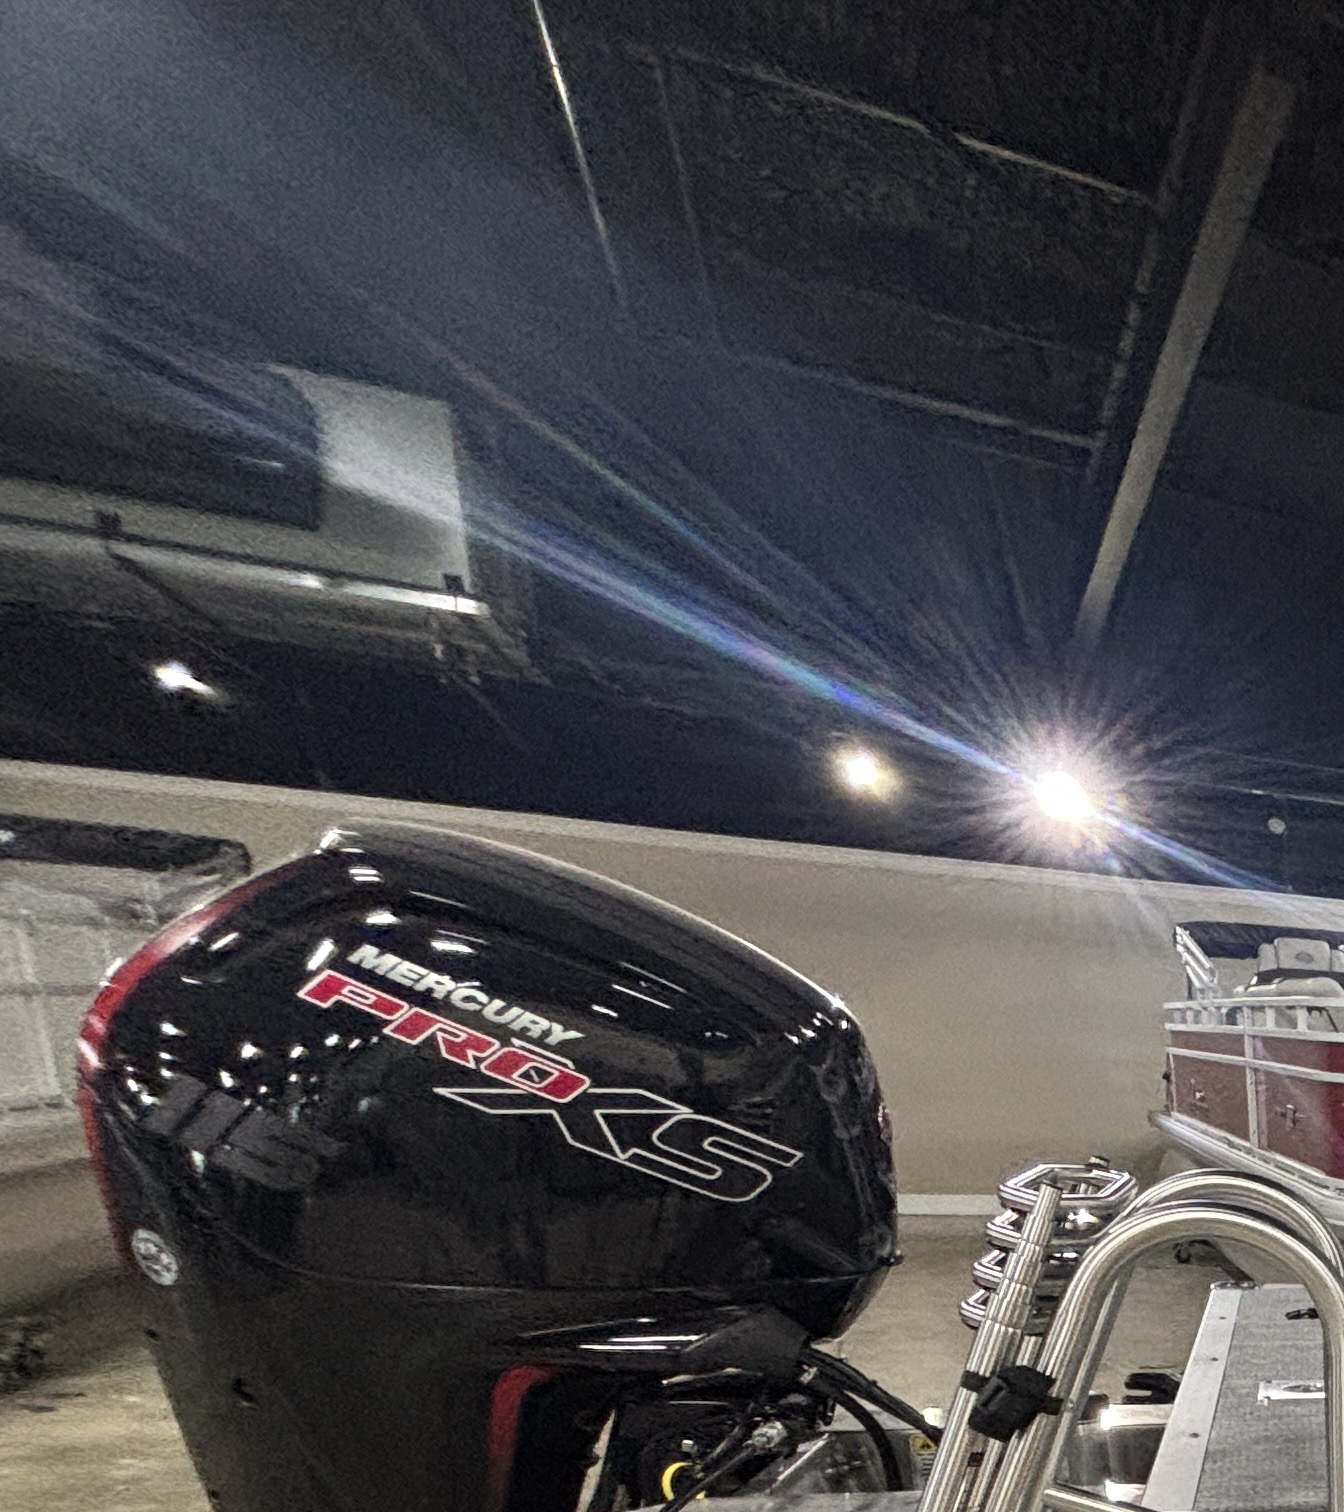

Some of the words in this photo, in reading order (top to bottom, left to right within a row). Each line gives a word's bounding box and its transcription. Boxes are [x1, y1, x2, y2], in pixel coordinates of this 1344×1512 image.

[297, 968, 591, 1103] PRO
[347, 943, 585, 1047] MERCURY
[433, 1087, 804, 1202] XS
